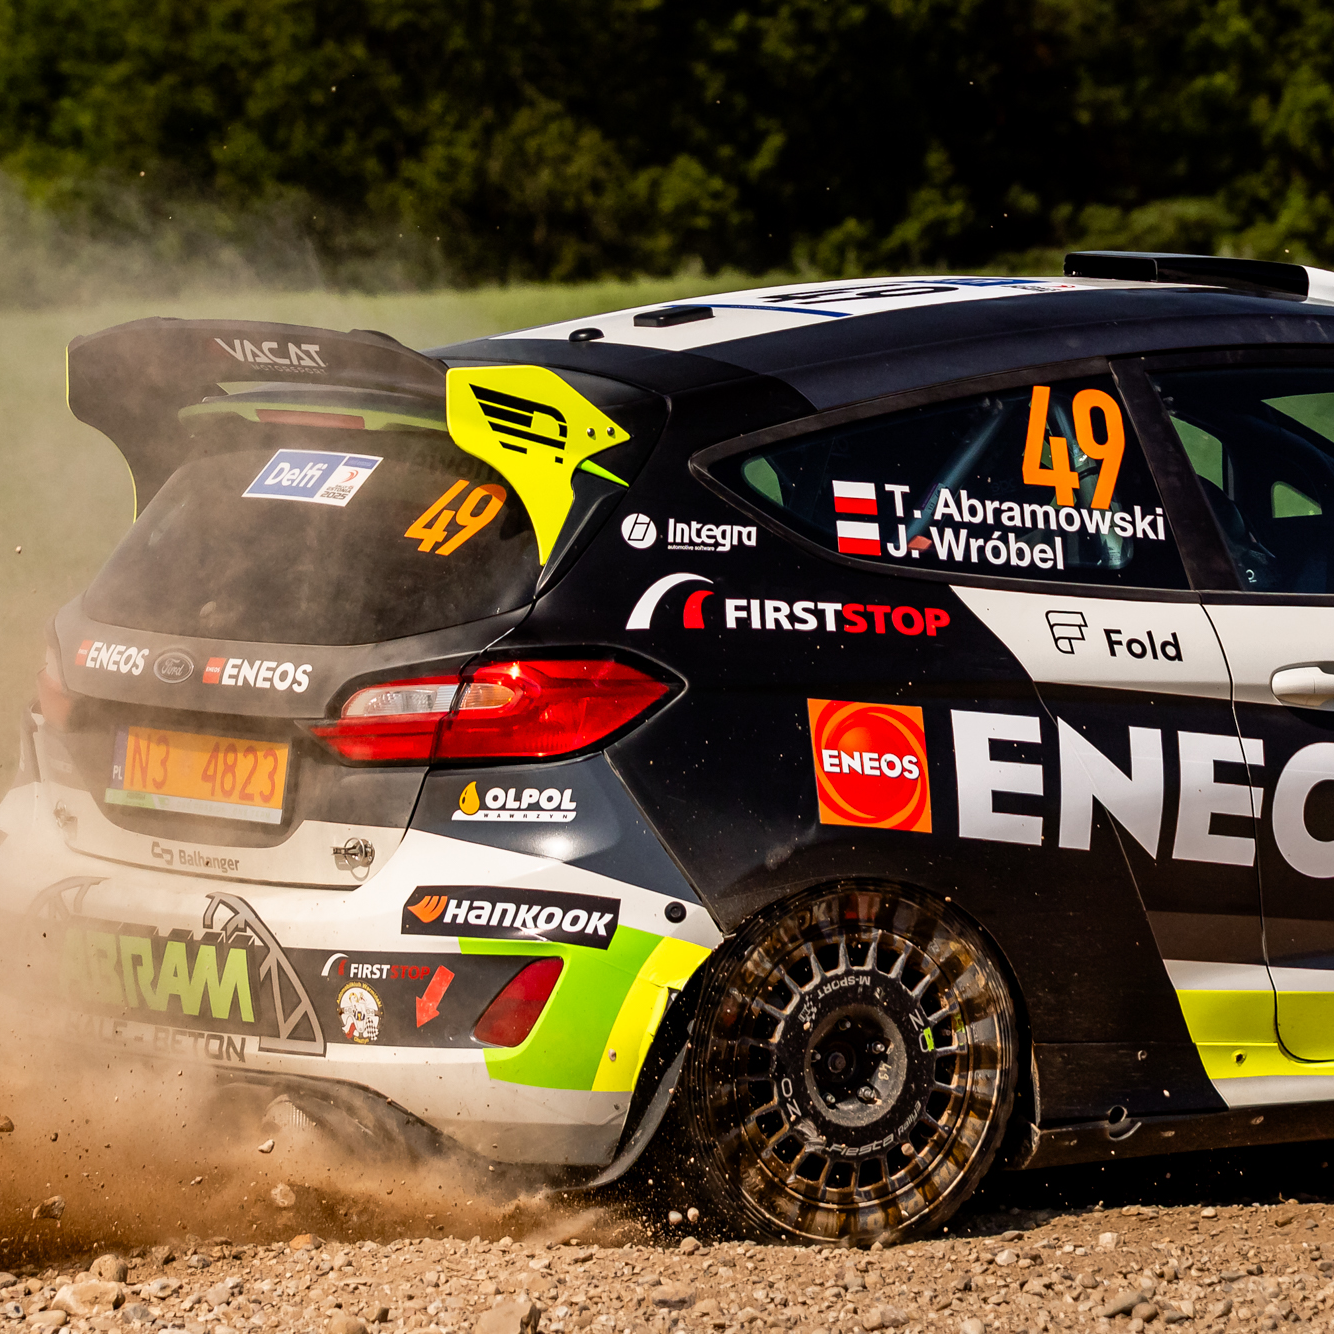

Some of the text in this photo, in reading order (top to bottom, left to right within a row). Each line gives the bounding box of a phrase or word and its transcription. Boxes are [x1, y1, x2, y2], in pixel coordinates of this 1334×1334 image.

[213, 337, 327, 367] VACAT
[1021, 385, 1126, 510] 49
[264, 462, 328, 488] Delfi
[319, 490, 349, 500] 2025
[884, 483, 1166, 541] T. Abramowski
[404, 479, 507, 557] 49
[667, 517, 757, 552] Integra
[886, 525, 1065, 571] J. Wróbel
[725, 598, 951, 637] FIRSTSTOP
[85, 641, 150, 676] ENEOS
[1103, 628, 1184, 662] Fold
[161, 657, 186, 677] Ford
[221, 658, 313, 693] ENEOS
[112, 765, 123, 780] PL
[130, 732, 279, 804] N3 4823
[821, 749, 920, 780] ENEOS
[484, 787, 577, 810] OLPOL
[178, 849, 240, 873] Balhanger
[350, 963, 431, 980] FIRSTSTOP
[817, 974, 871, 1000] M-SPORT
[153, 1026, 247, 1063] BETON
